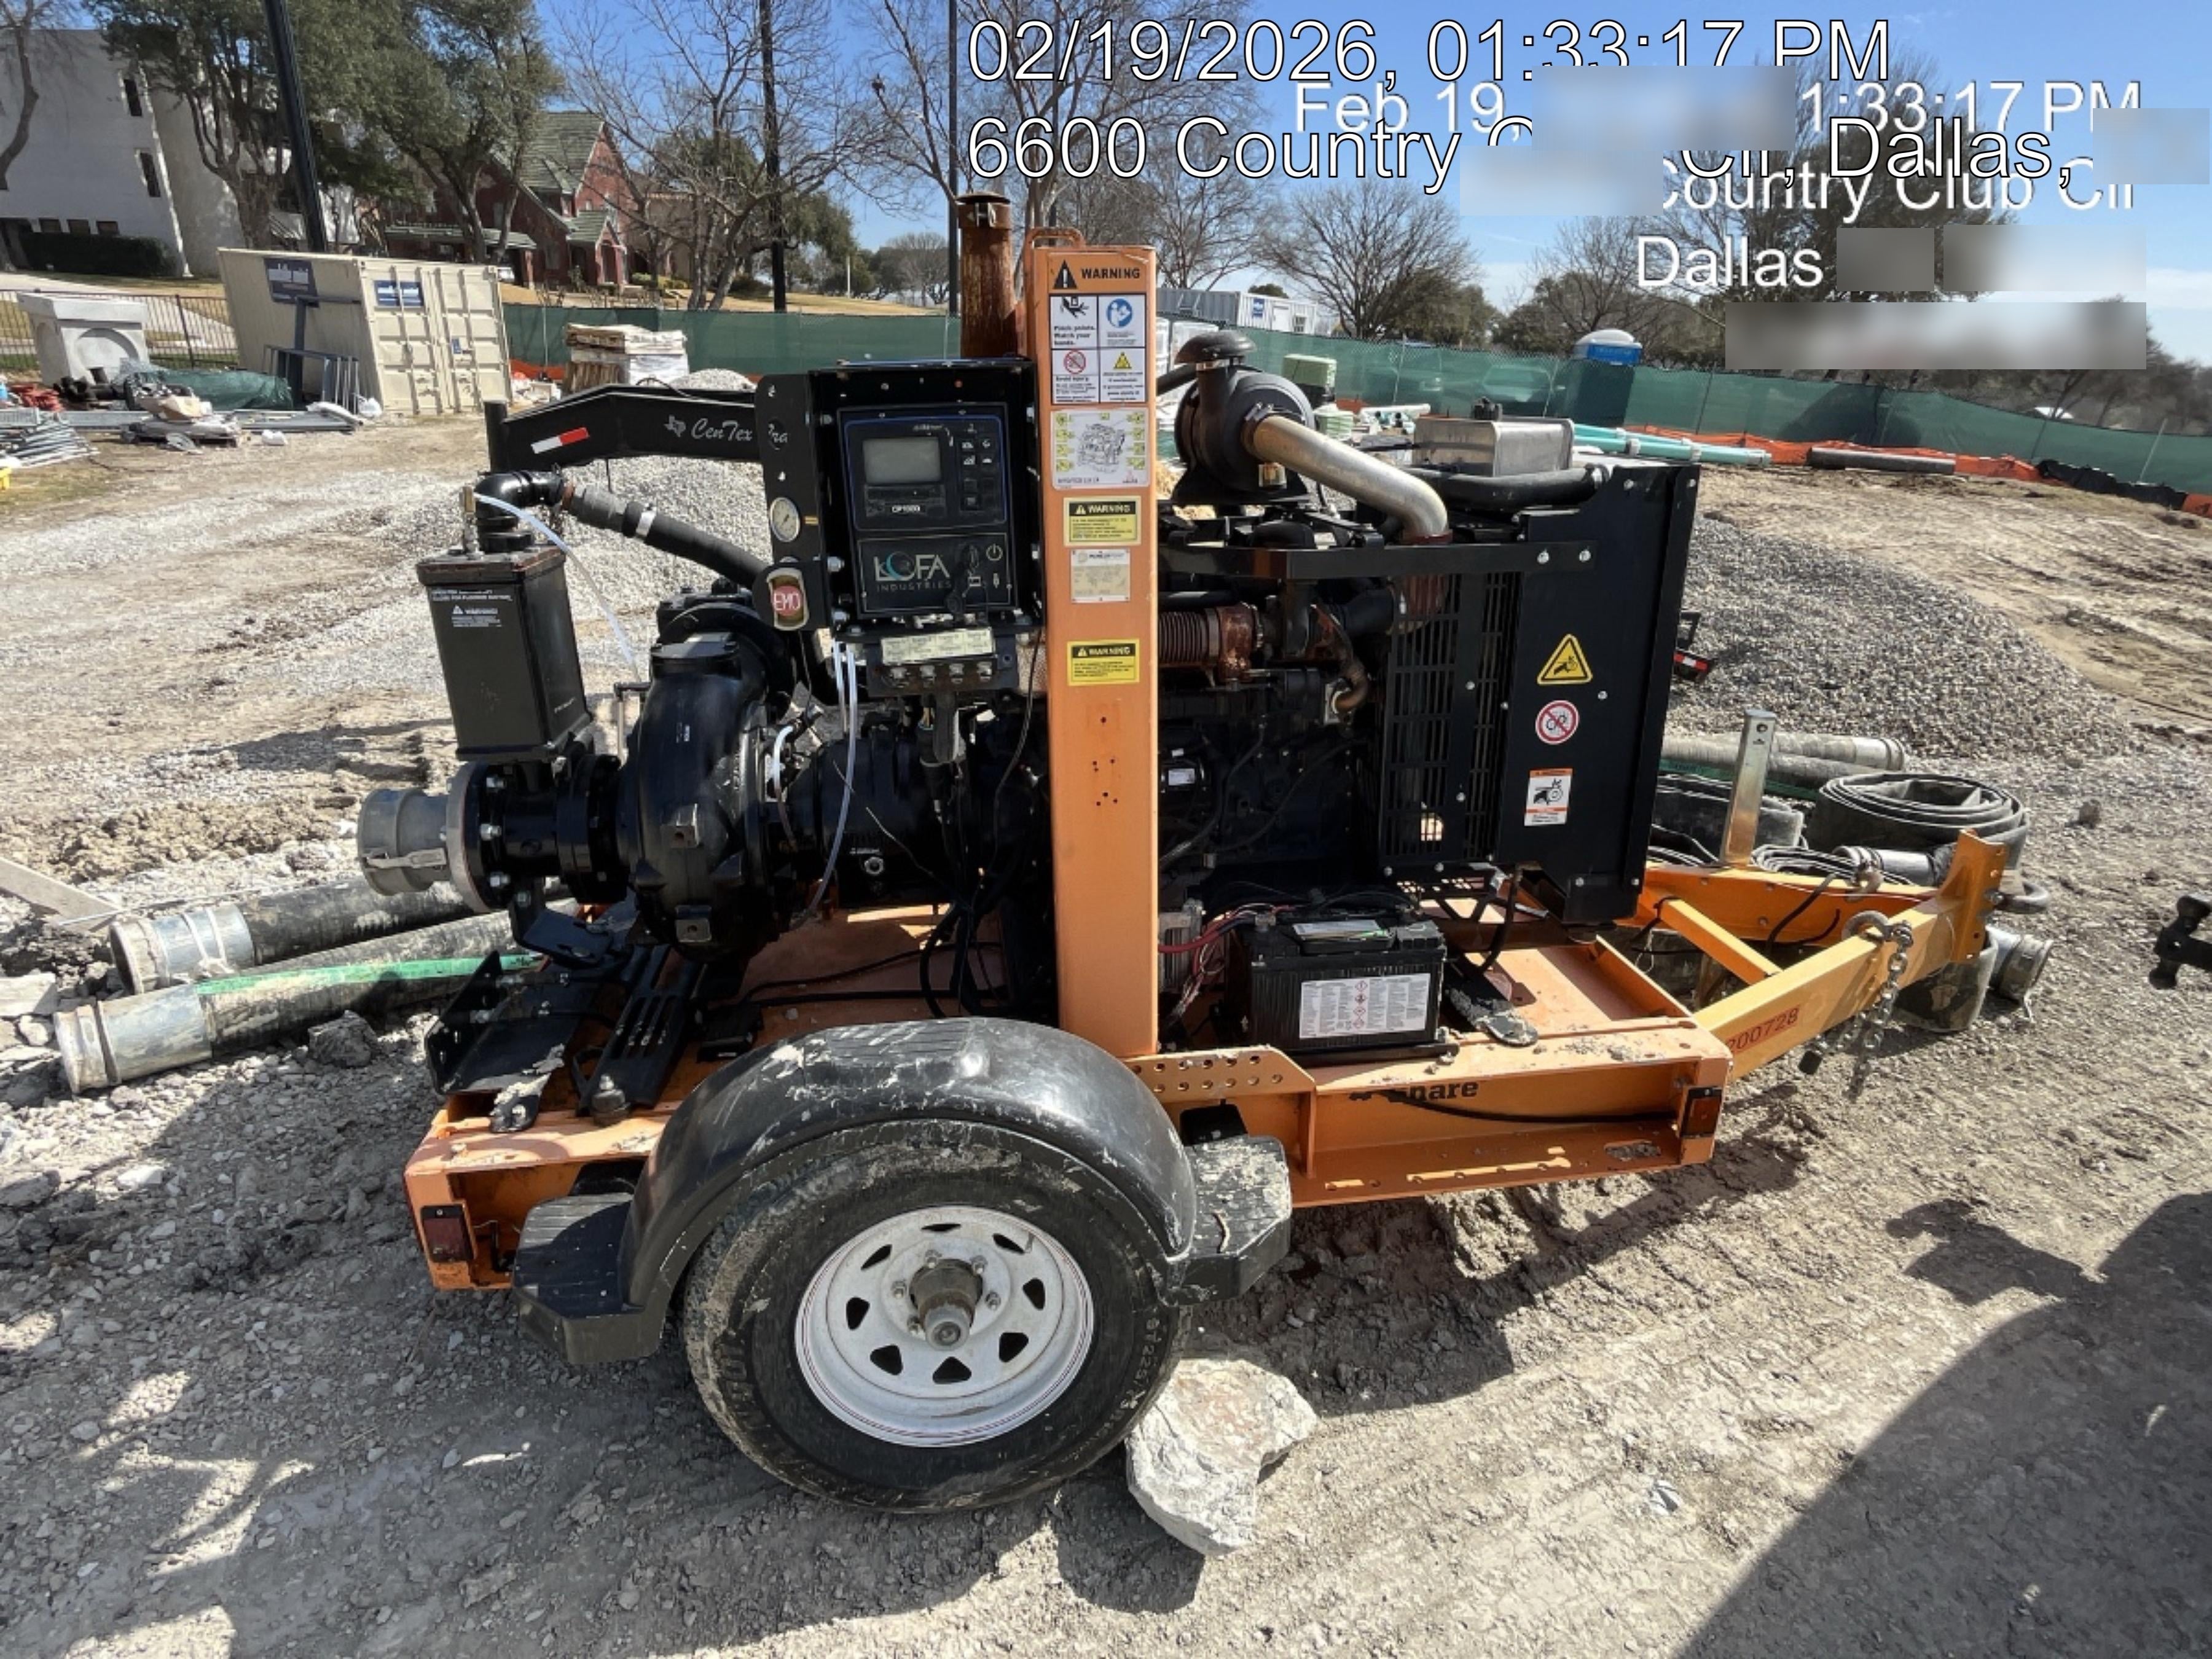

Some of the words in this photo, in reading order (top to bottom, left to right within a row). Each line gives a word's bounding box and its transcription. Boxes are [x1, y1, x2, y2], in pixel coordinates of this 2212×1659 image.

[1080, 267, 1140, 280] WARNING
[690, 417, 753, 442] CenTex
[1088, 504, 1131, 514] WARNING
[876, 579, 952, 592] INDUSTRIES
[1088, 646, 1131, 656] WARNING
